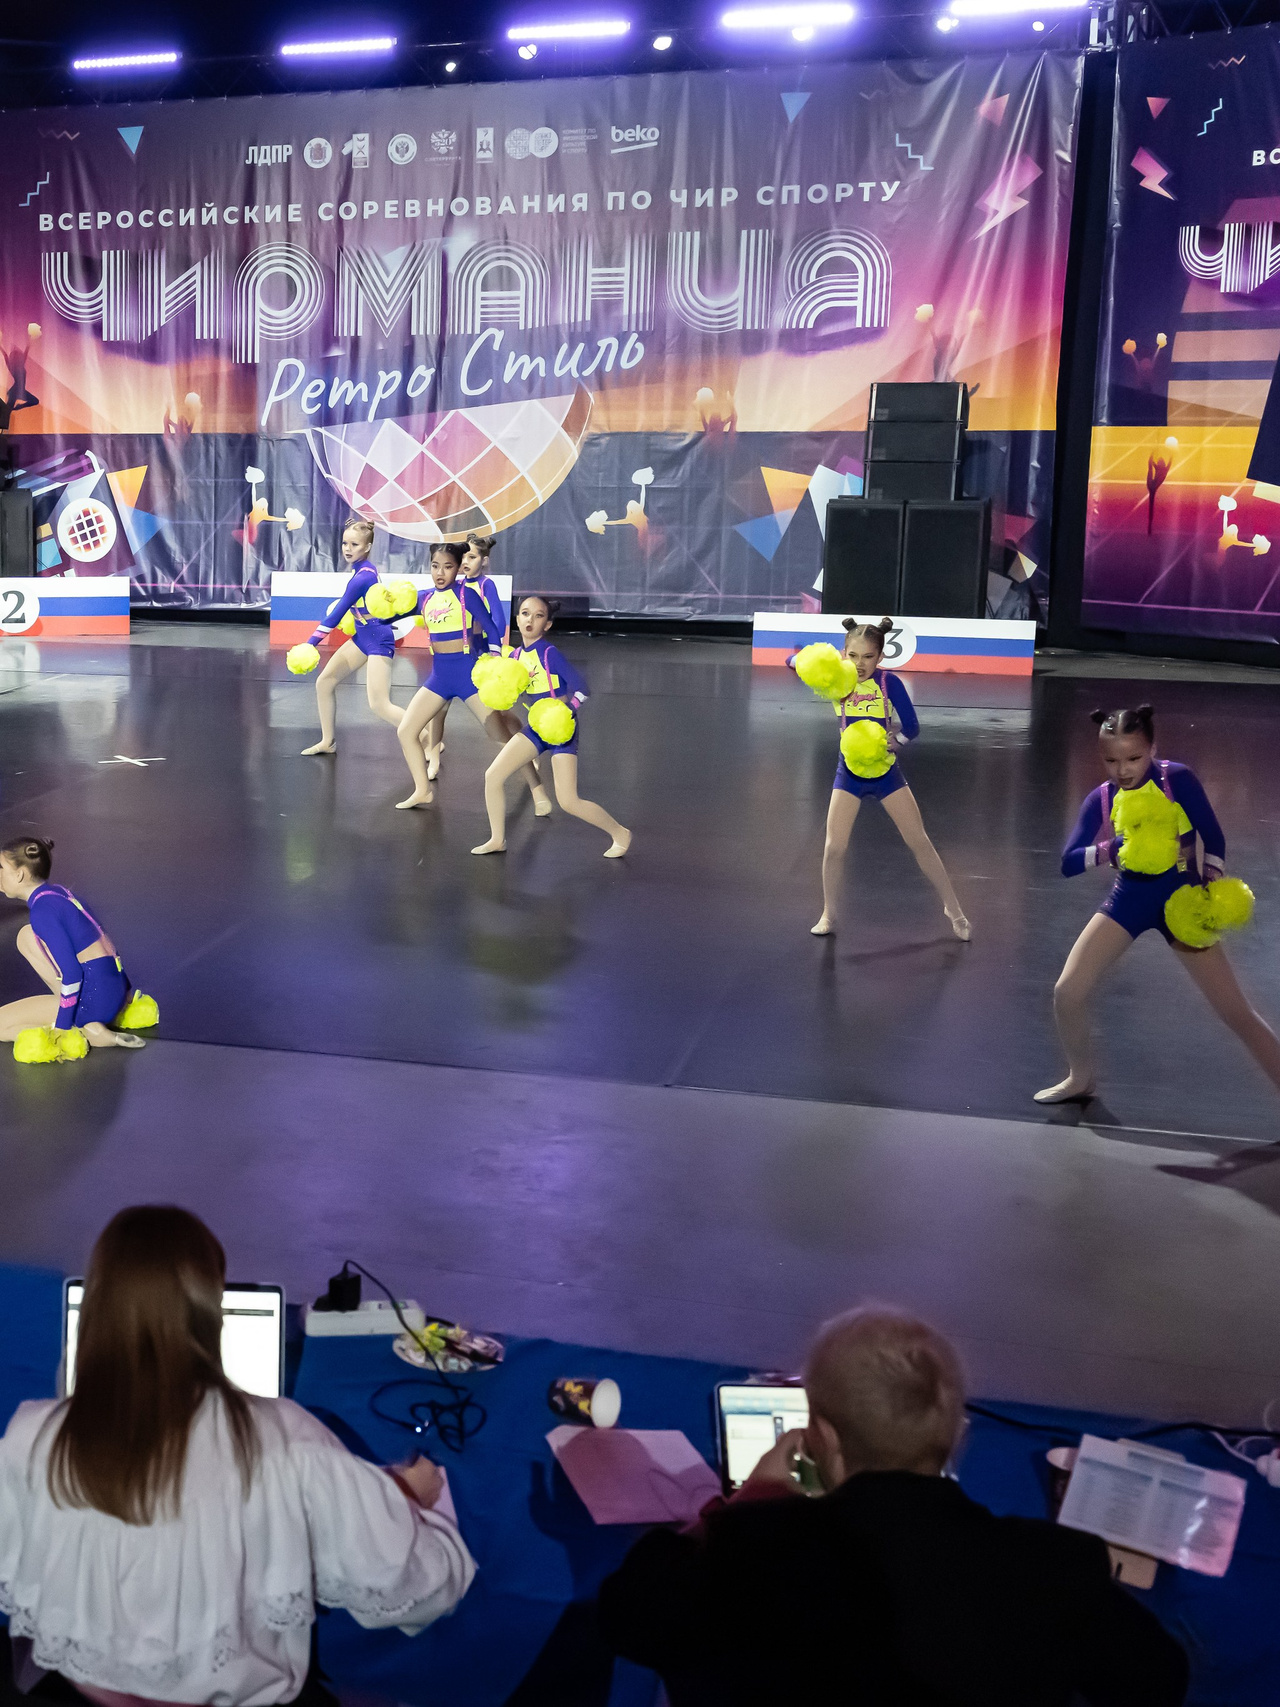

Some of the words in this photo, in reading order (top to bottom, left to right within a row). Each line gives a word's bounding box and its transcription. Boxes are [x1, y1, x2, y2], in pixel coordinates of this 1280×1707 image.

[610, 124, 660, 143] beko
[245, 144, 293, 166] ЛДПР
[38, 202, 303, 232] ВСЕРОССИЙСКИЕ
[317, 192, 589, 221] СОРЕВНОВАНИЯ
[606, 190, 652, 211] ПО
[669, 187, 740, 208] ЧИР
[756, 180, 901, 206] СПОРТУ
[260, 357, 437, 427] Ретро
[459, 328, 646, 397] Стиль
[1, 590, 26, 624] 2
[882, 628, 904, 659] 3
